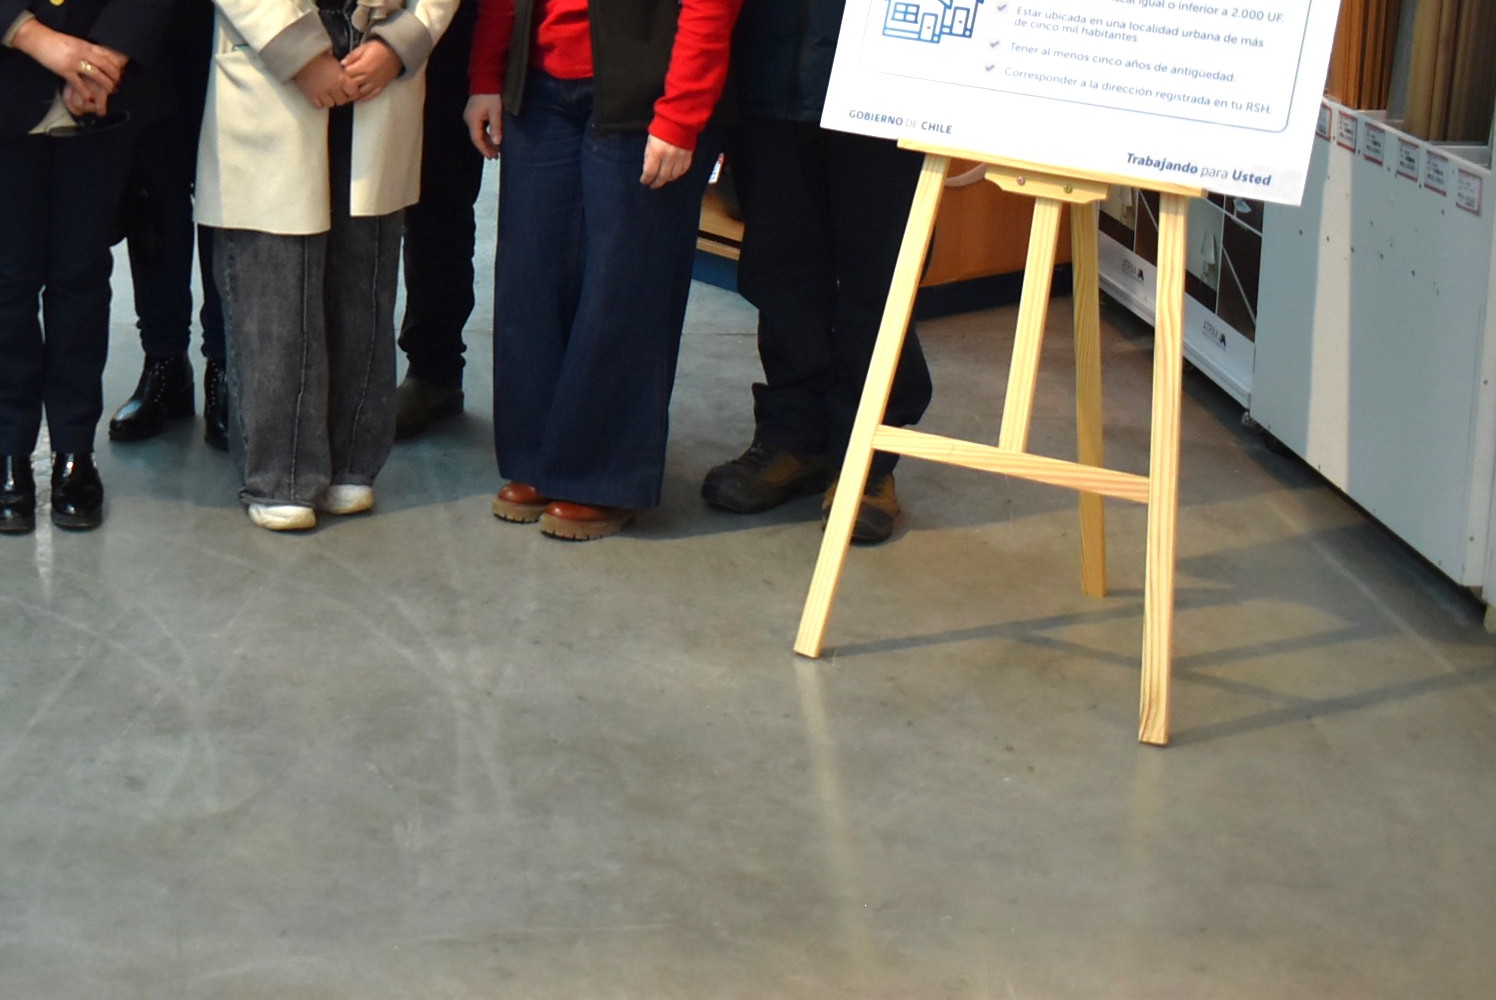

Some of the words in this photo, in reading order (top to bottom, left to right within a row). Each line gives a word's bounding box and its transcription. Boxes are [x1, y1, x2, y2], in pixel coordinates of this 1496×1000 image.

[1127, 152, 1198, 174] Trabajando
[1200, 167, 1229, 179] para
[1232, 169, 1272, 186] Usted
